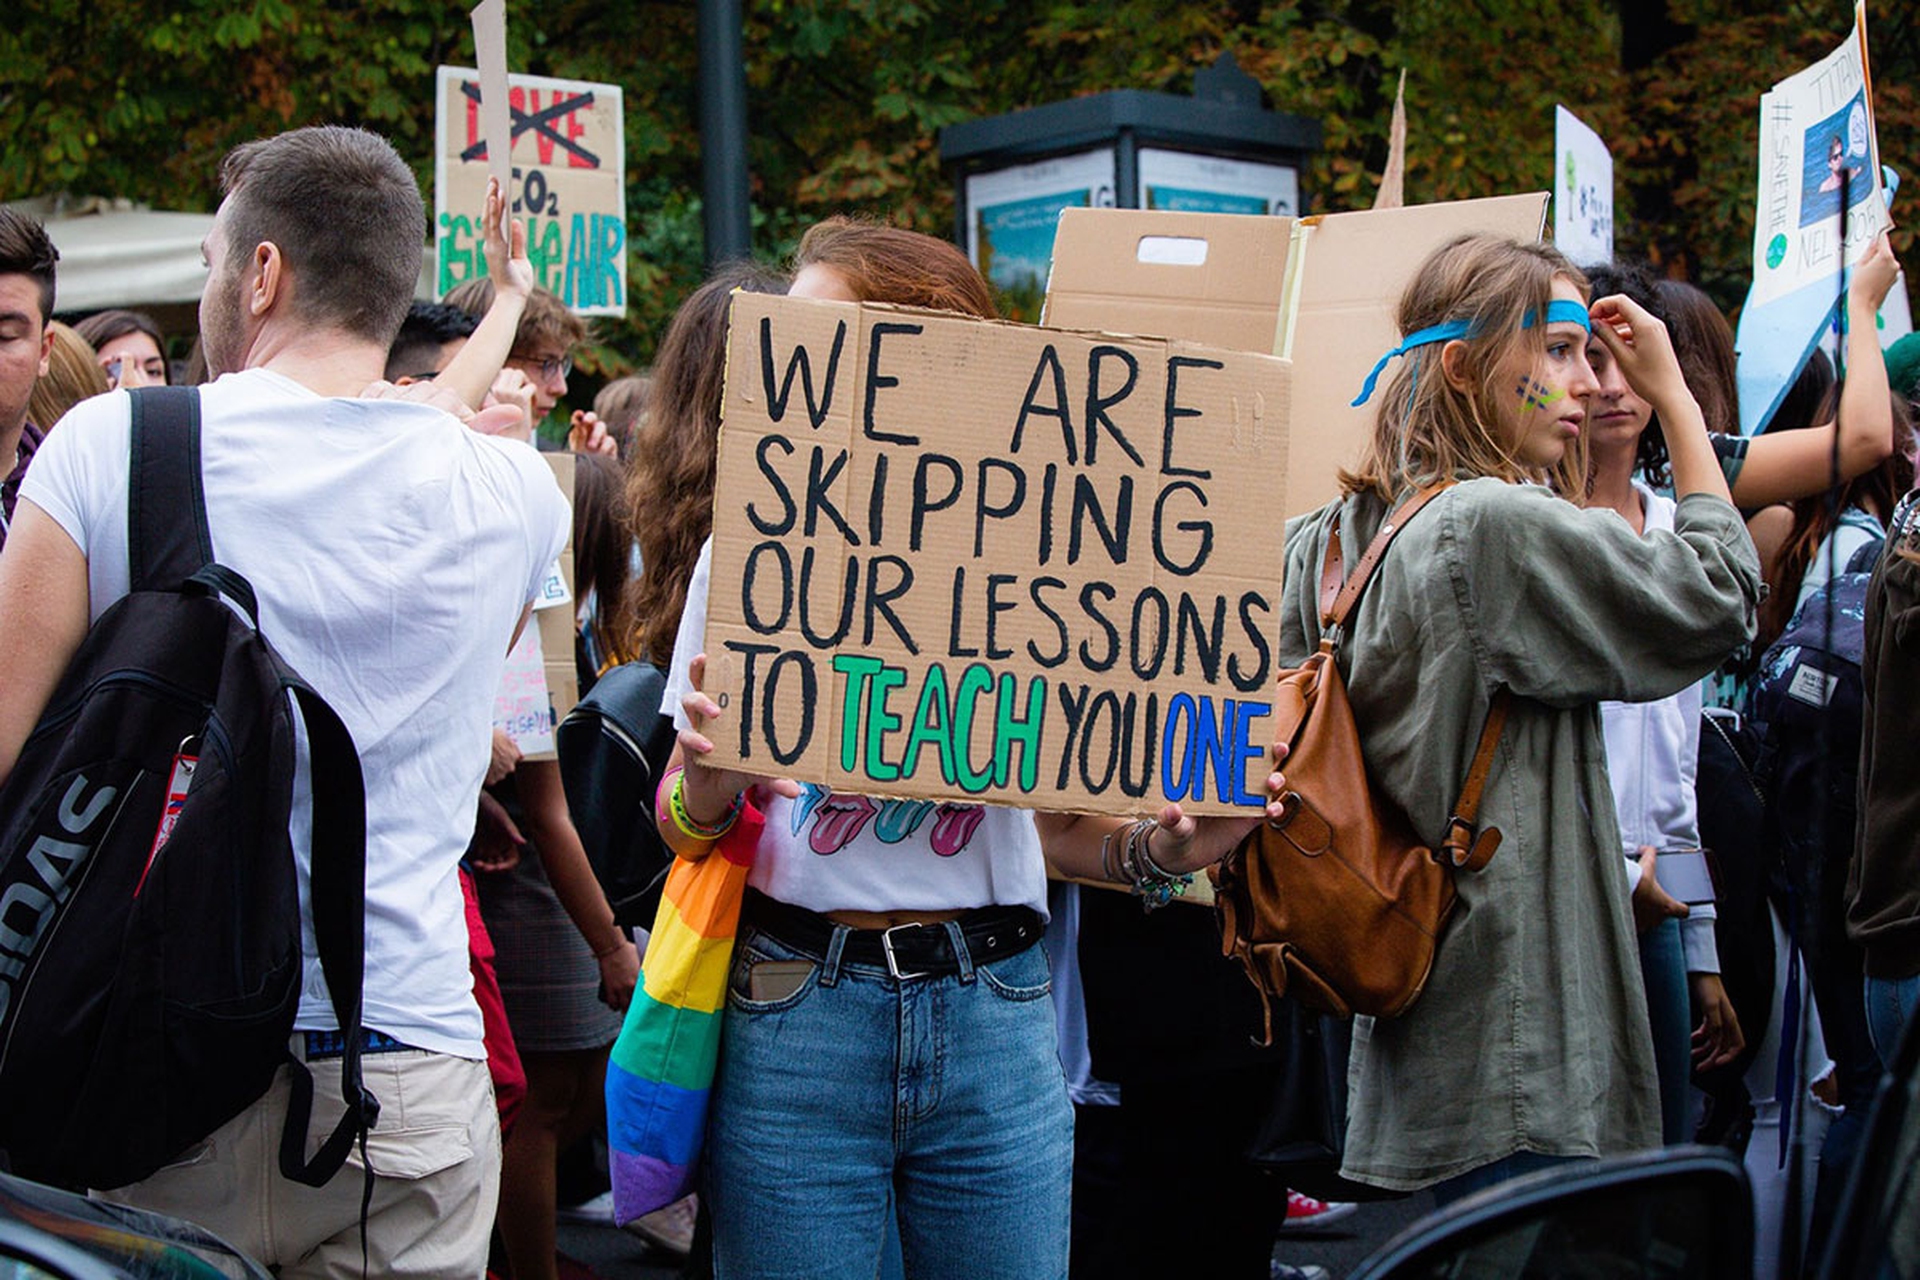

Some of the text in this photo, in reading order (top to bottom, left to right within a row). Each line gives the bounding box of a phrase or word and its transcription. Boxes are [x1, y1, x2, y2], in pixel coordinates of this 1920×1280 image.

[563, 212, 626, 308] AIR
[760, 316, 1224, 479] WE ARE
[746, 434, 1214, 576] SKIPPING
[742, 540, 1271, 692] OUR LESSONS
[724, 640, 1272, 808] TO TEACH YOU ONE
[0, 774, 117, 1026] IDAS
